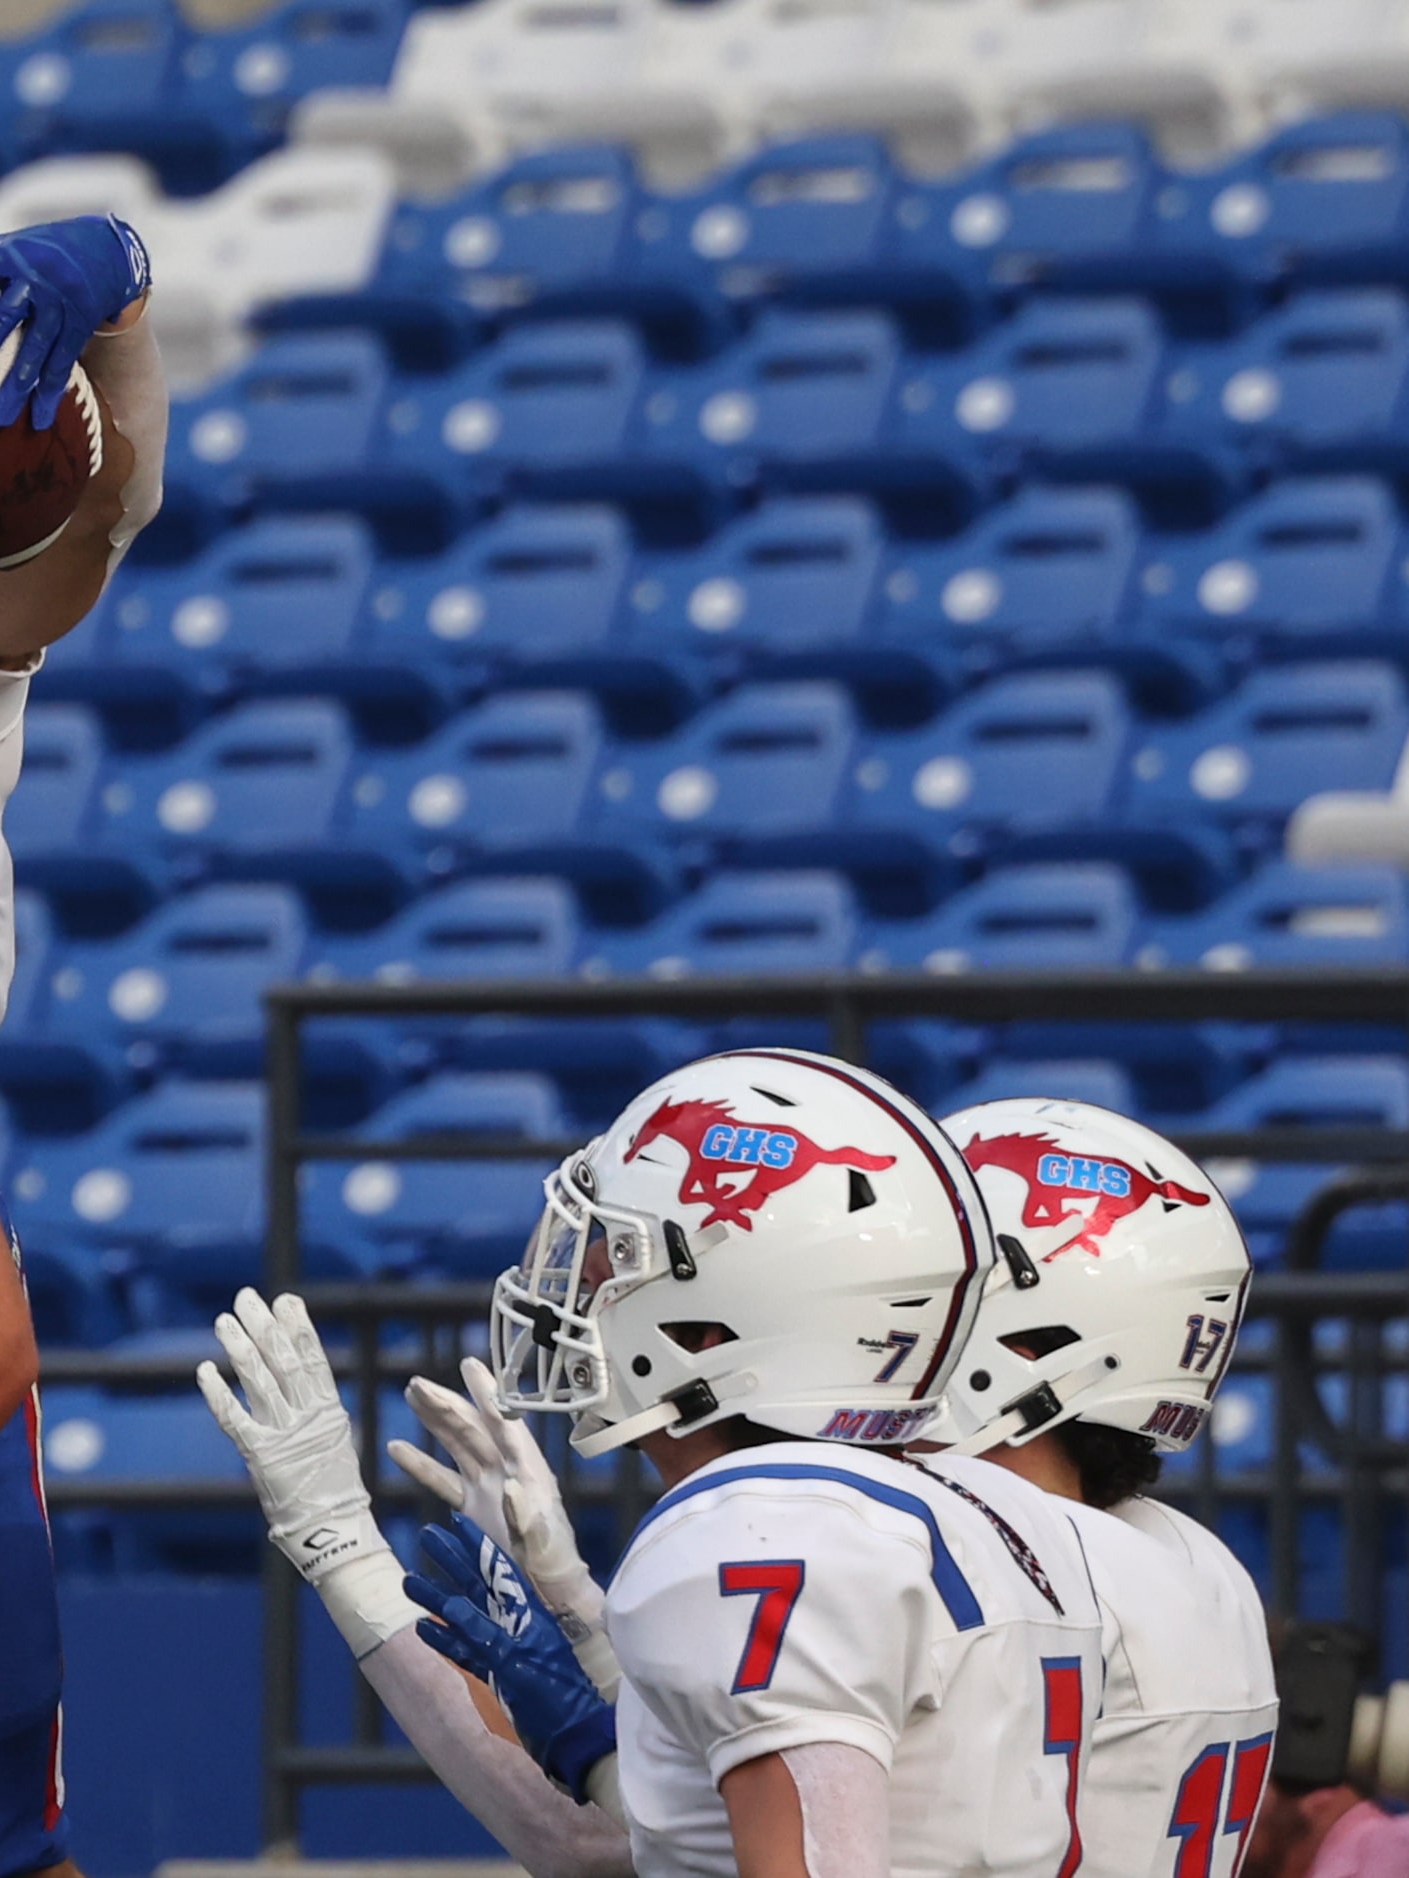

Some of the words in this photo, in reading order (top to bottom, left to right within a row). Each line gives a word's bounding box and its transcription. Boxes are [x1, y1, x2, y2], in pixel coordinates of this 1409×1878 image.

[698, 1123, 799, 1170] GHS
[1036, 1153, 1132, 1198] GHS
[873, 1329, 919, 1383] 7
[1179, 1314, 1228, 1373] 17
[718, 1559, 805, 1696] 7
